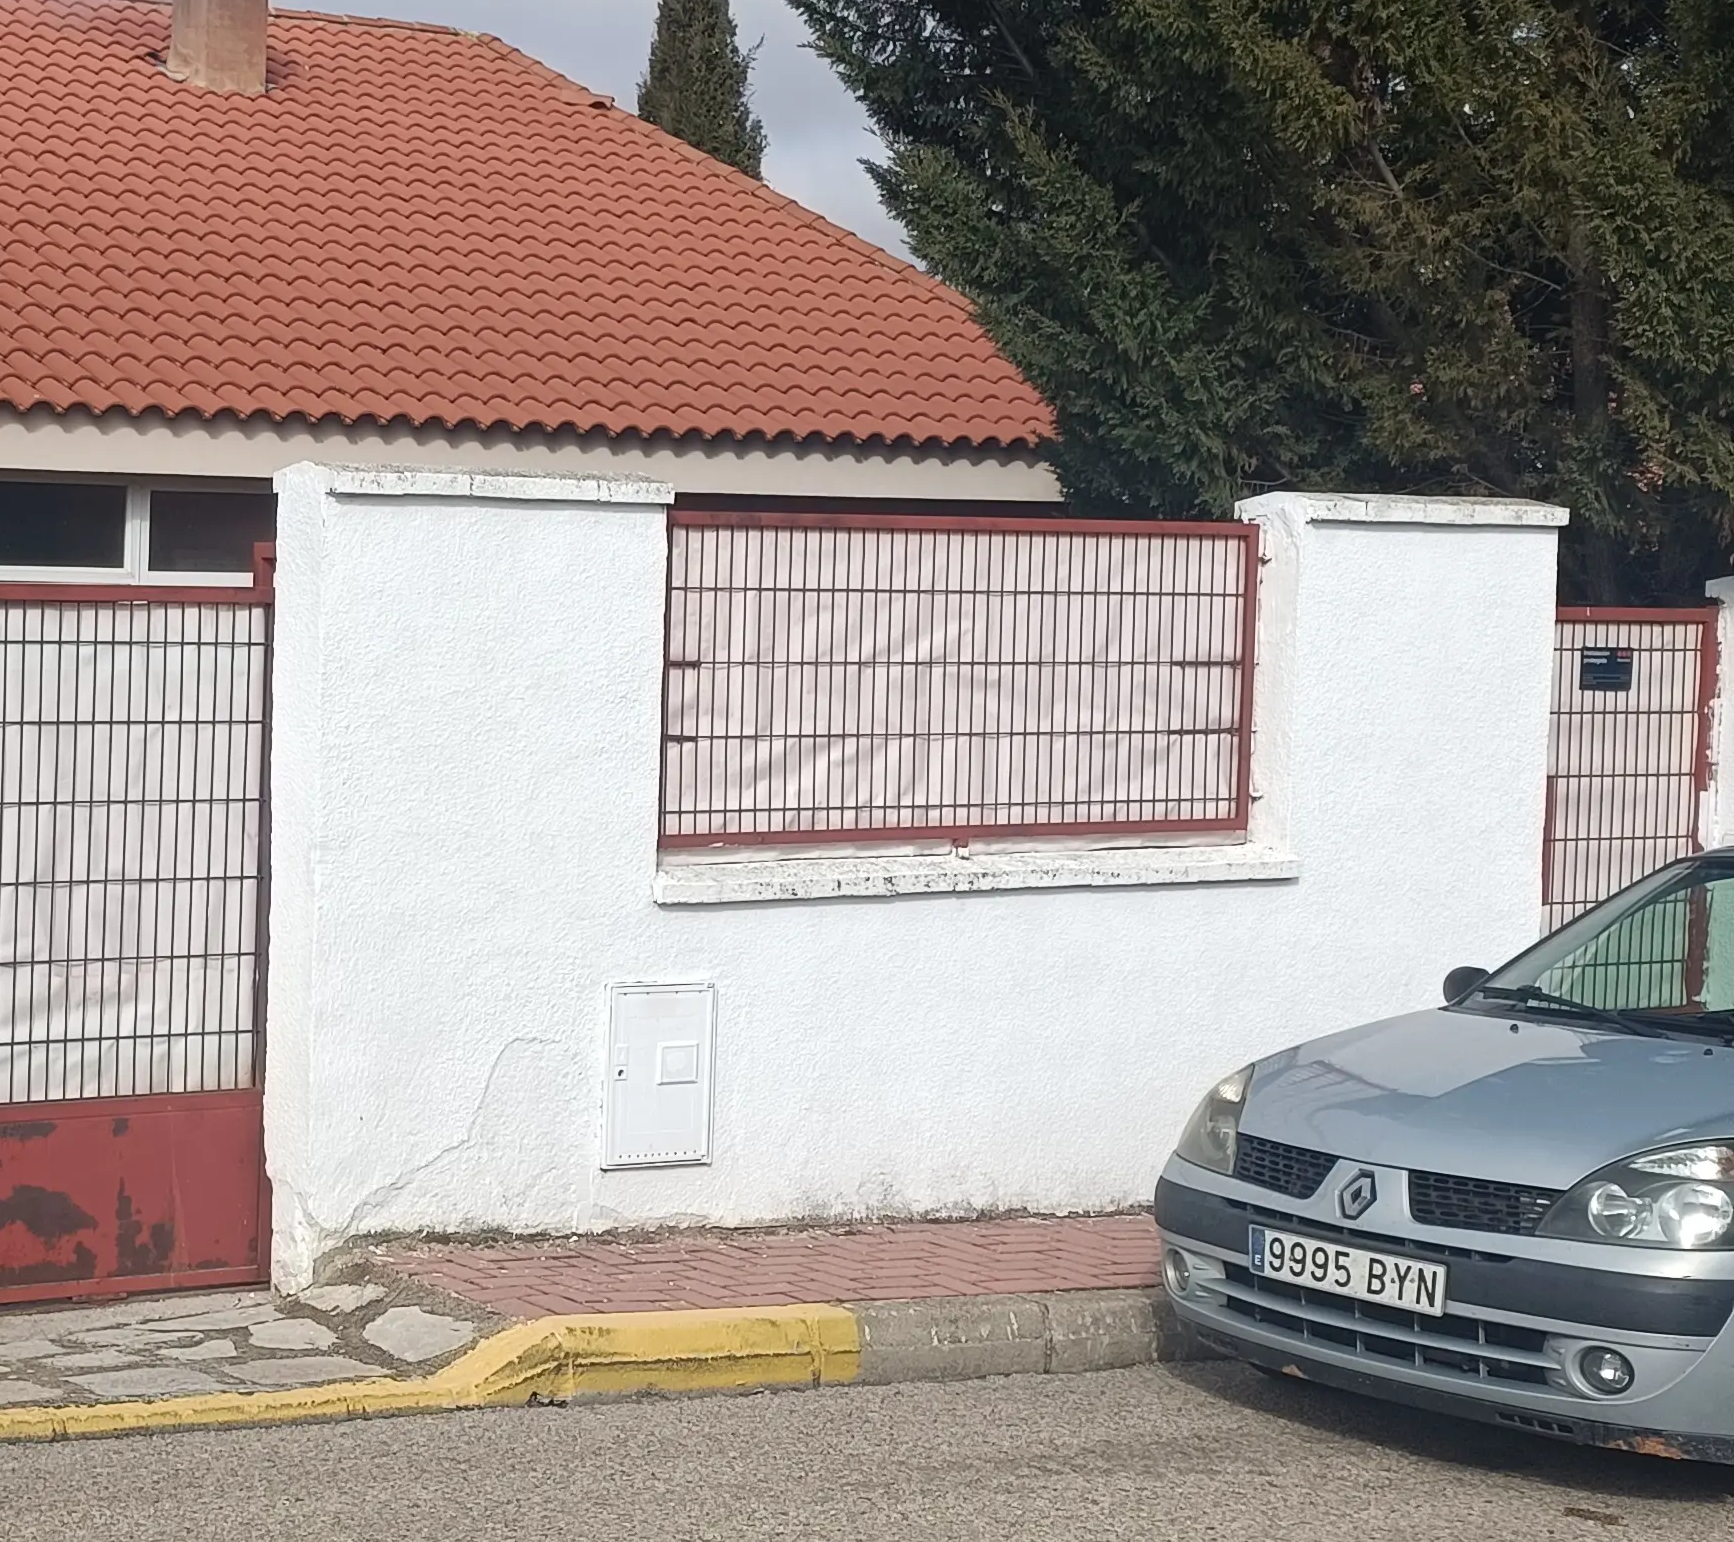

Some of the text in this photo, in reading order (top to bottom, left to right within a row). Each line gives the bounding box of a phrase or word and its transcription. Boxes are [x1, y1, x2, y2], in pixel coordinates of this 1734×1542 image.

[1254, 1254, 1262, 1266] E
[1269, 1237, 1438, 1308] 9995 BYN
